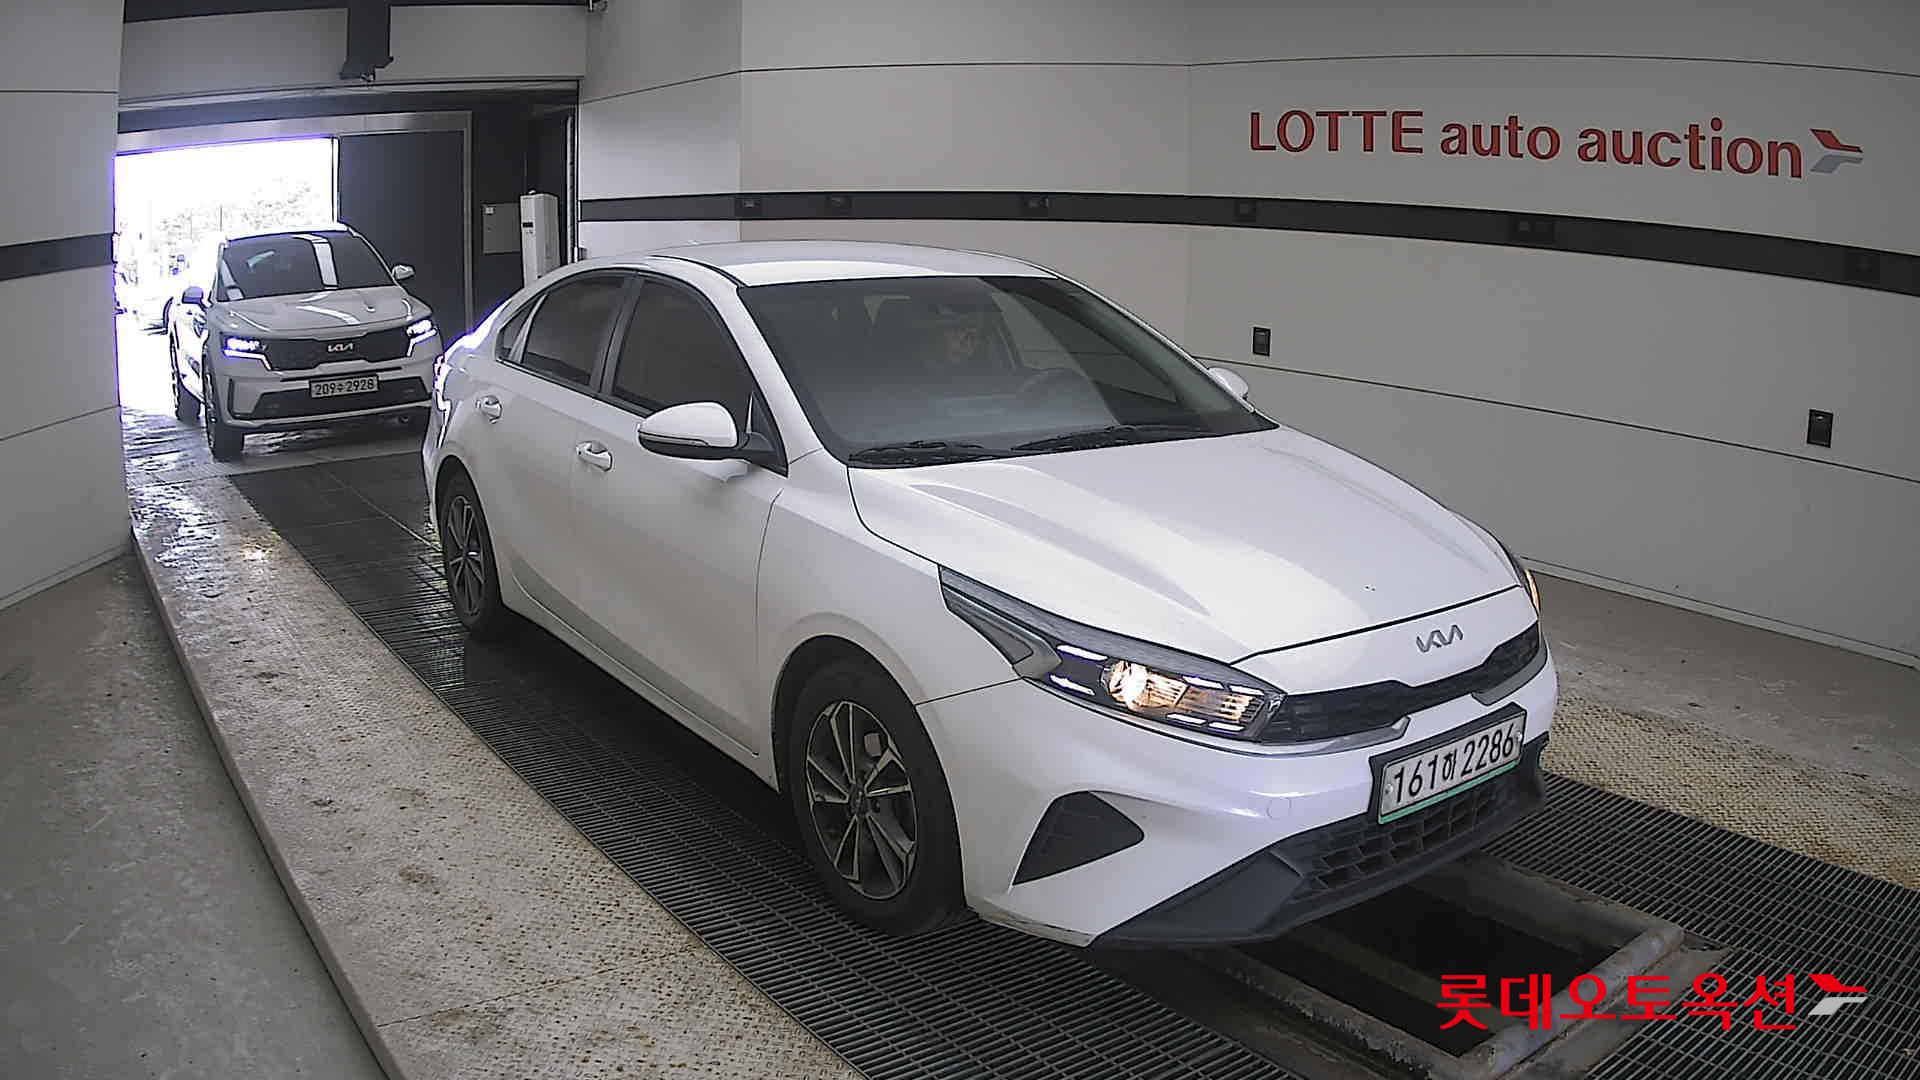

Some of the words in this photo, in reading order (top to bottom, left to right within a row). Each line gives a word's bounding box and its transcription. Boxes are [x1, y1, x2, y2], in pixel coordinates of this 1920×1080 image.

[1250, 110, 1424, 153] LOTTE
[1440, 115, 1561, 162] auto
[1577, 117, 1803, 179] auction
